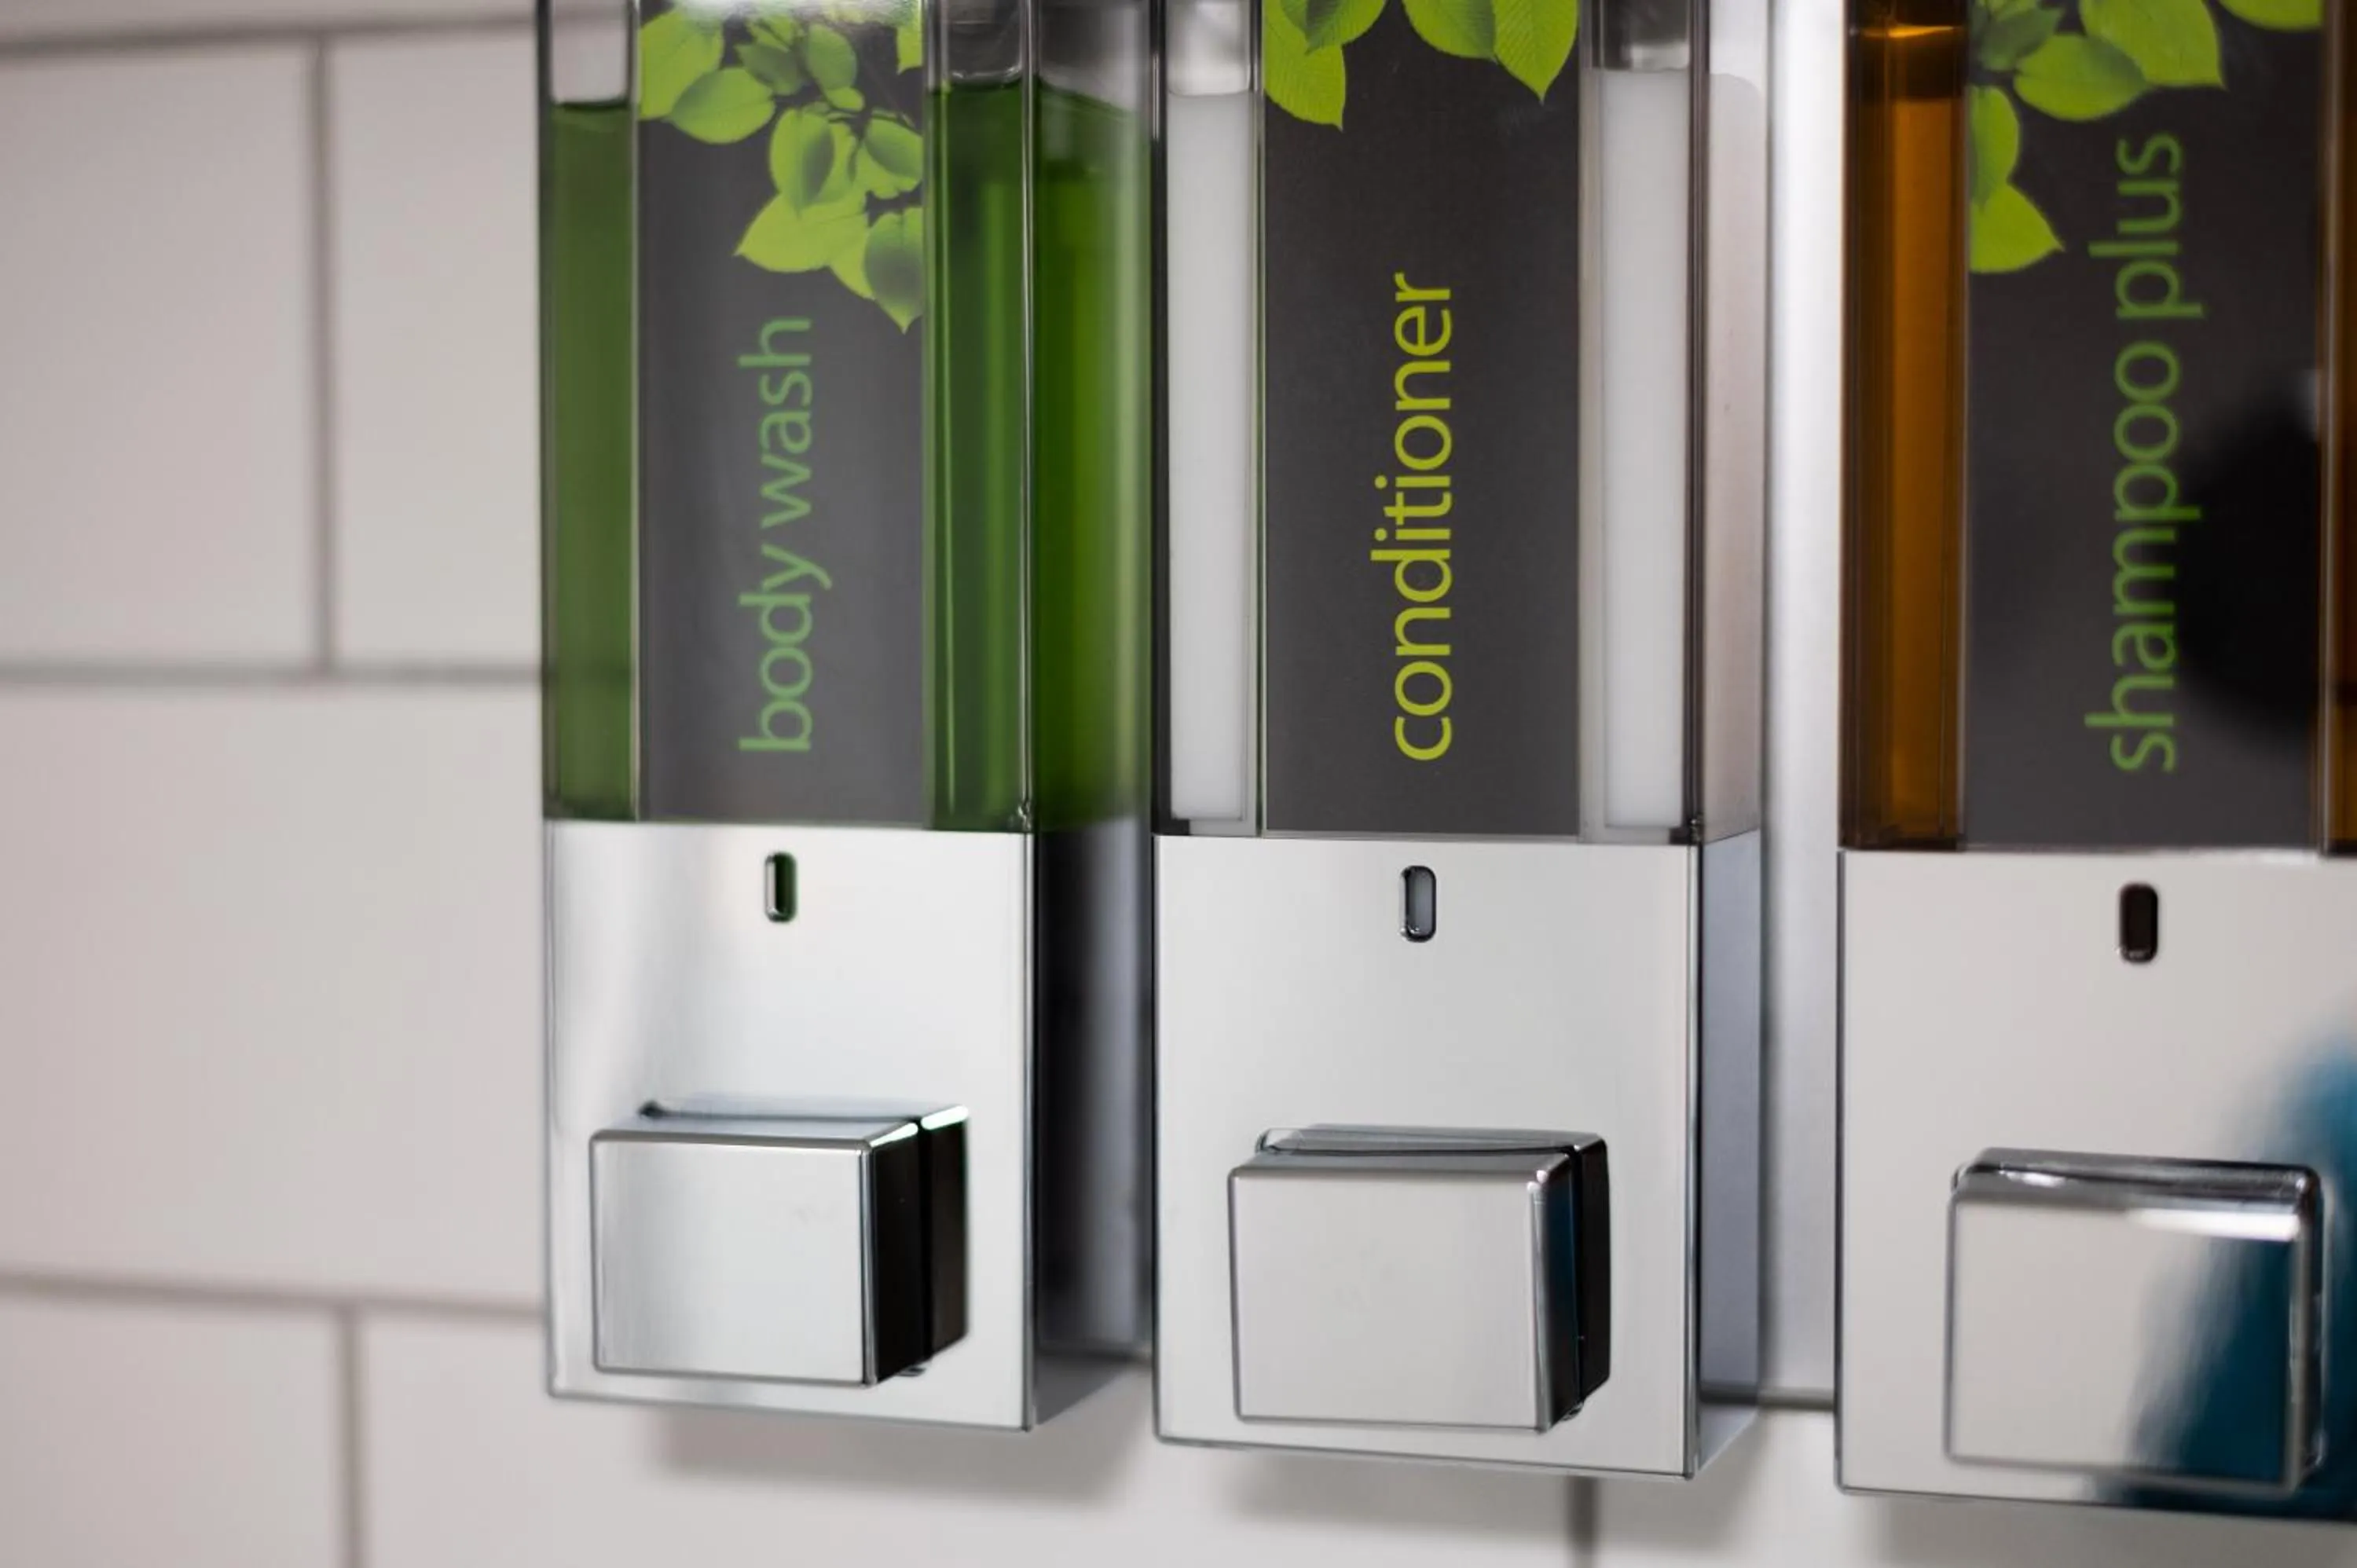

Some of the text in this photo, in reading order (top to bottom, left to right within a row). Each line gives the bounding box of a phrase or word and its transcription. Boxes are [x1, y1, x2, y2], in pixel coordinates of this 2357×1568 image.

[737, 317, 832, 753] body wash
[1370, 272, 1453, 762] conditioner
[2084, 131, 2203, 773] shampoo plus
